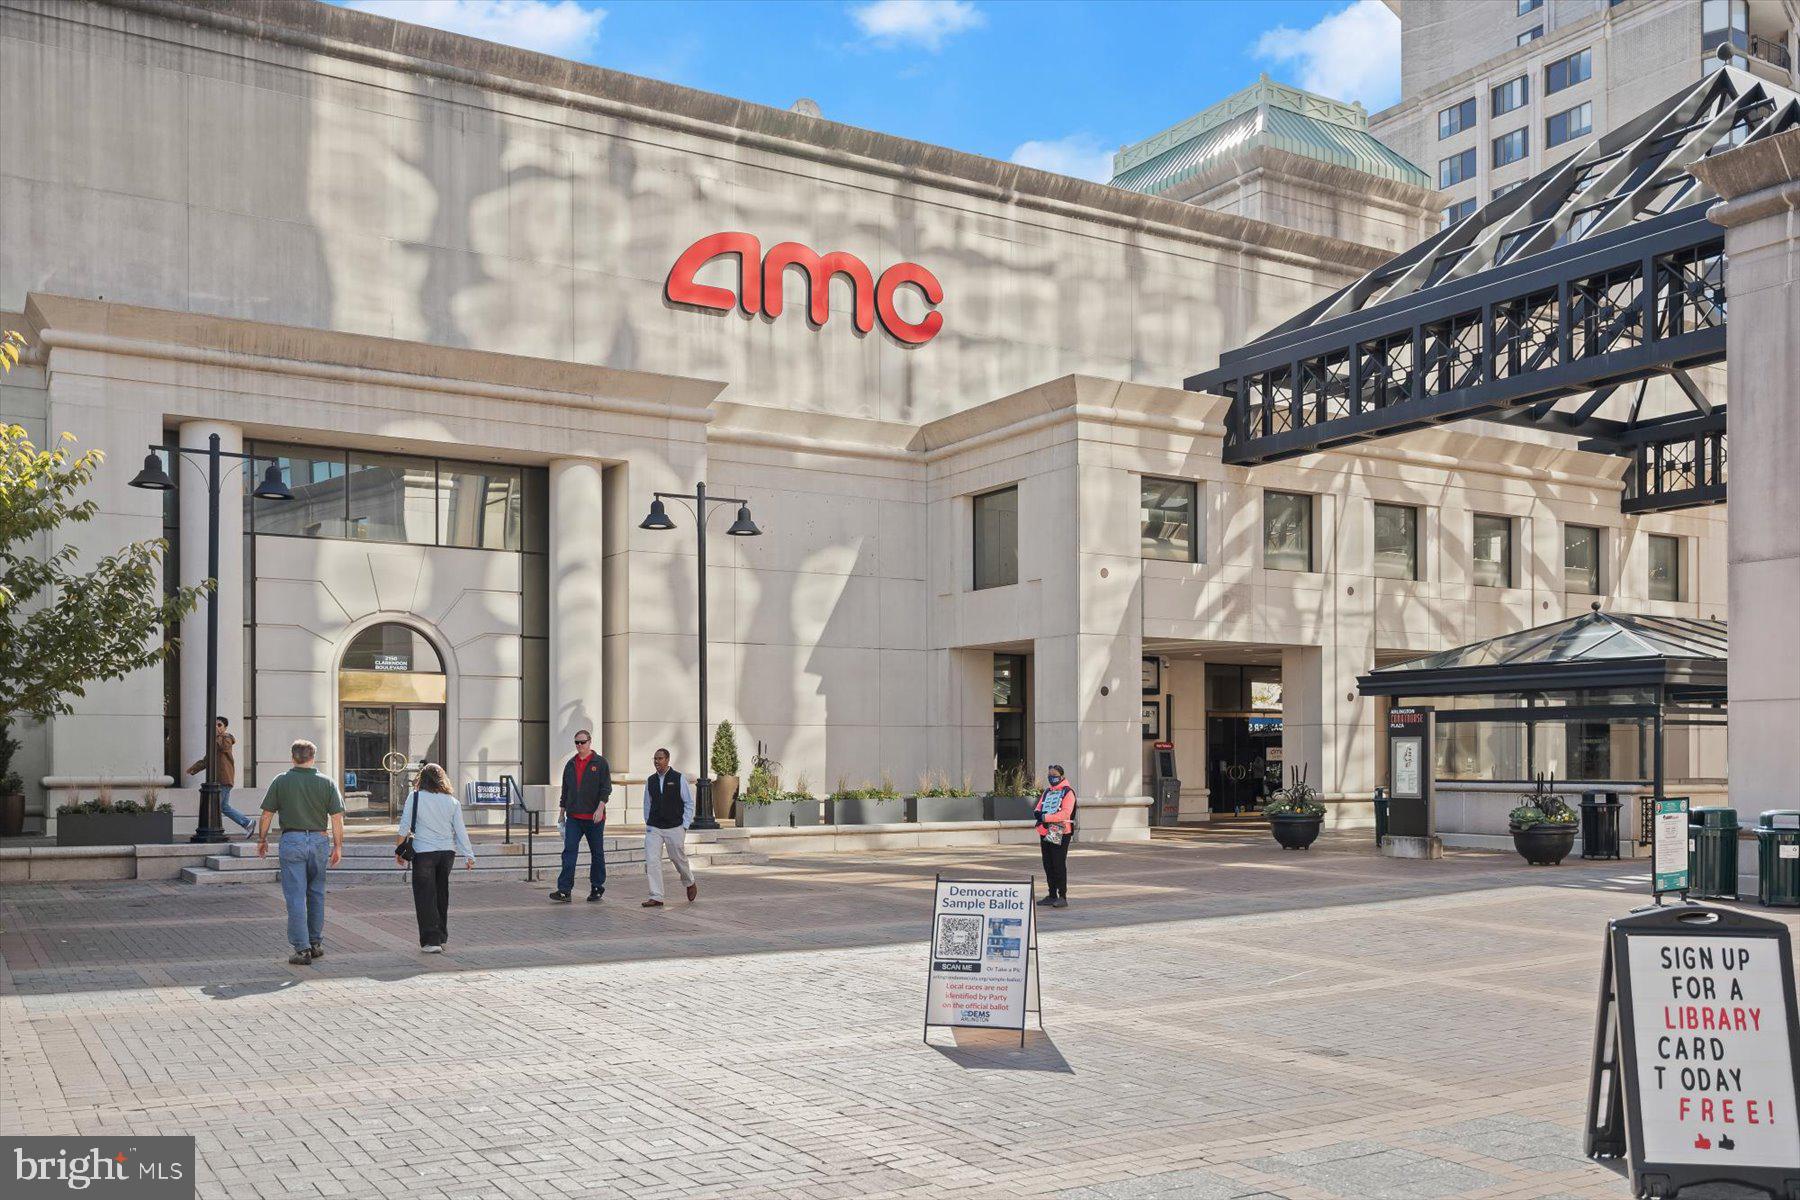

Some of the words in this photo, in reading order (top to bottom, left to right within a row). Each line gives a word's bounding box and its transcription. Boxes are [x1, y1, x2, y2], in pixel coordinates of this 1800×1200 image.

[665, 231, 944, 346] amc
[1390, 713, 1424, 723] COURTHOUSE
[942, 897, 985, 910] Sample
[989, 899, 1024, 910] Ballot
[949, 886, 1019, 898] Democratic
[941, 963, 960, 971] SCAN
[1660, 946, 1714, 970] SIGN
[1721, 948, 1750, 971] UP
[945, 991, 977, 1000] identified
[978, 993, 987, 1001] by
[988, 993, 1008, 1001] Party
[1671, 976, 1716, 1000] FOR
[1730, 978, 1744, 1000] A
[1664, 1005, 1761, 1032] LIBRARY
[1657, 1036, 1725, 1061] CARD
[1679, 1097, 1775, 1125] FREE!
